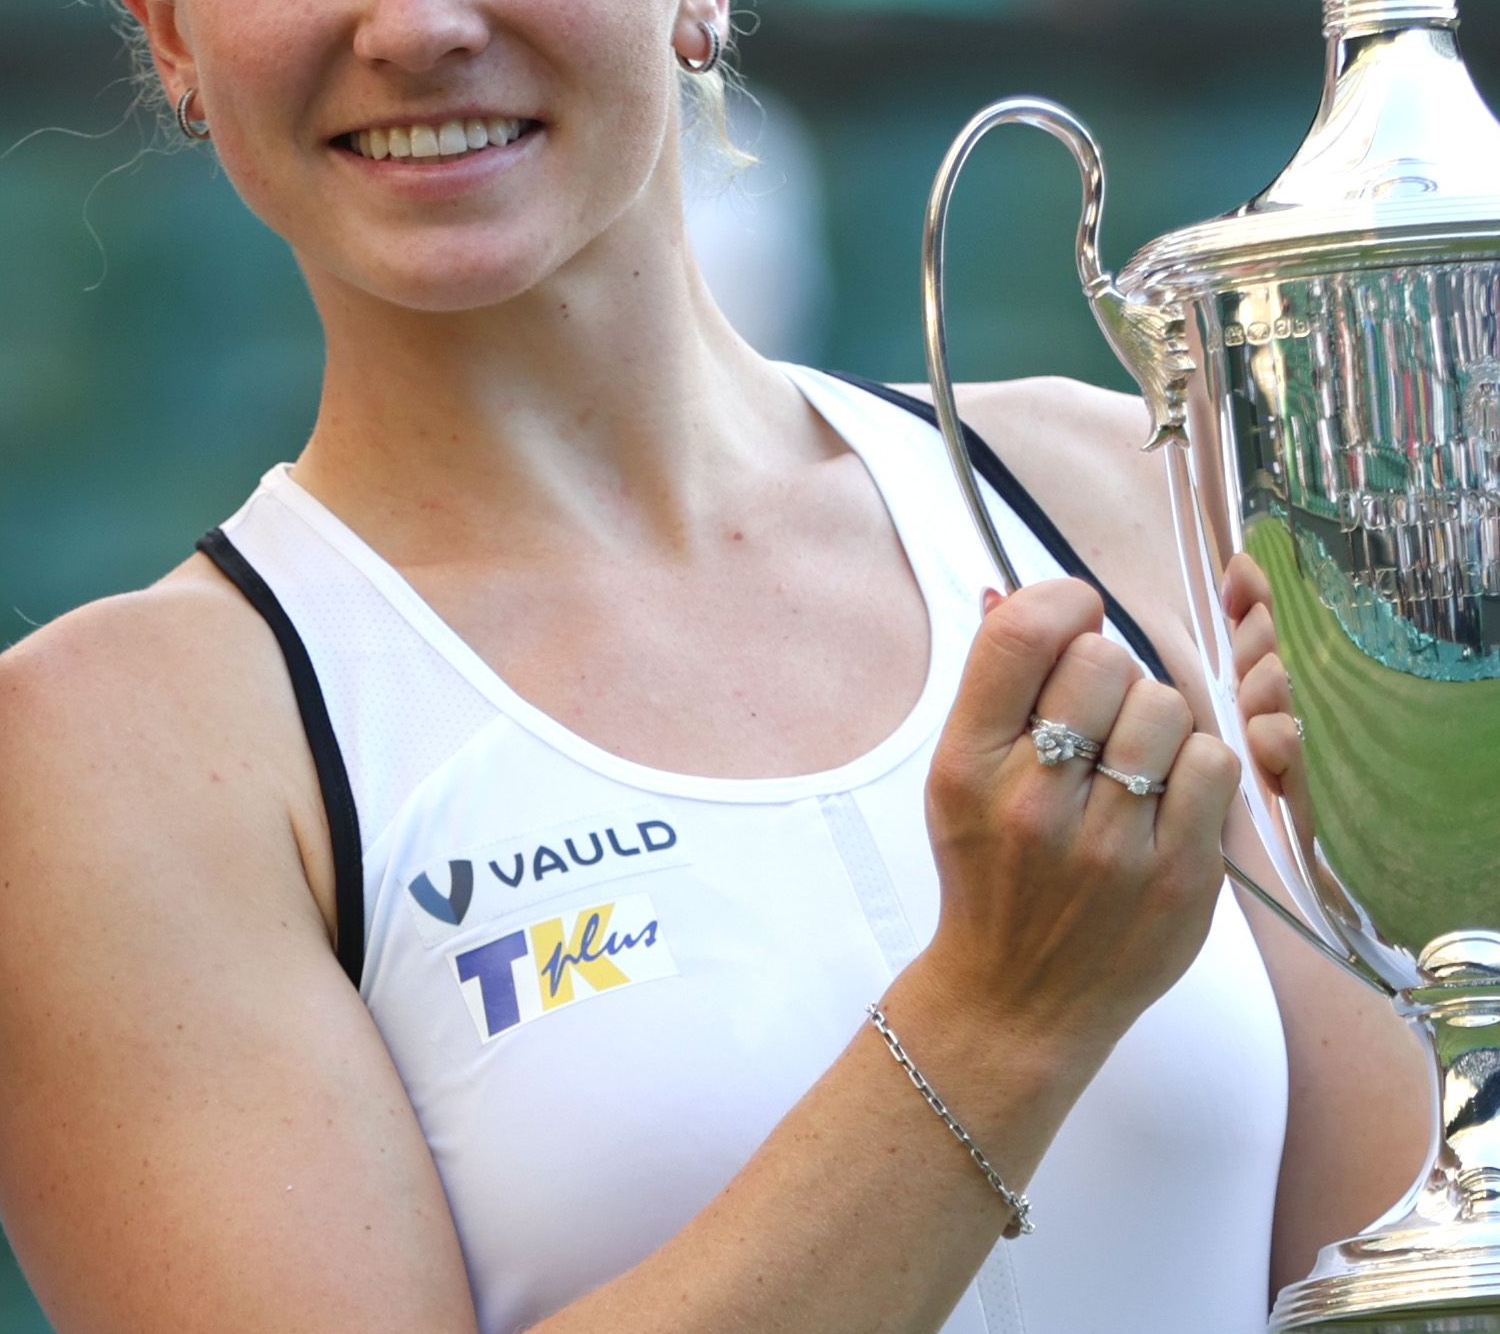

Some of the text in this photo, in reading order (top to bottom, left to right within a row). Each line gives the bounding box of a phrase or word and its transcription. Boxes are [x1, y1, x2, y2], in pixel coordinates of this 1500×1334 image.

[488, 819, 677, 889] VAULD
[455, 901, 659, 1037] TK plus
